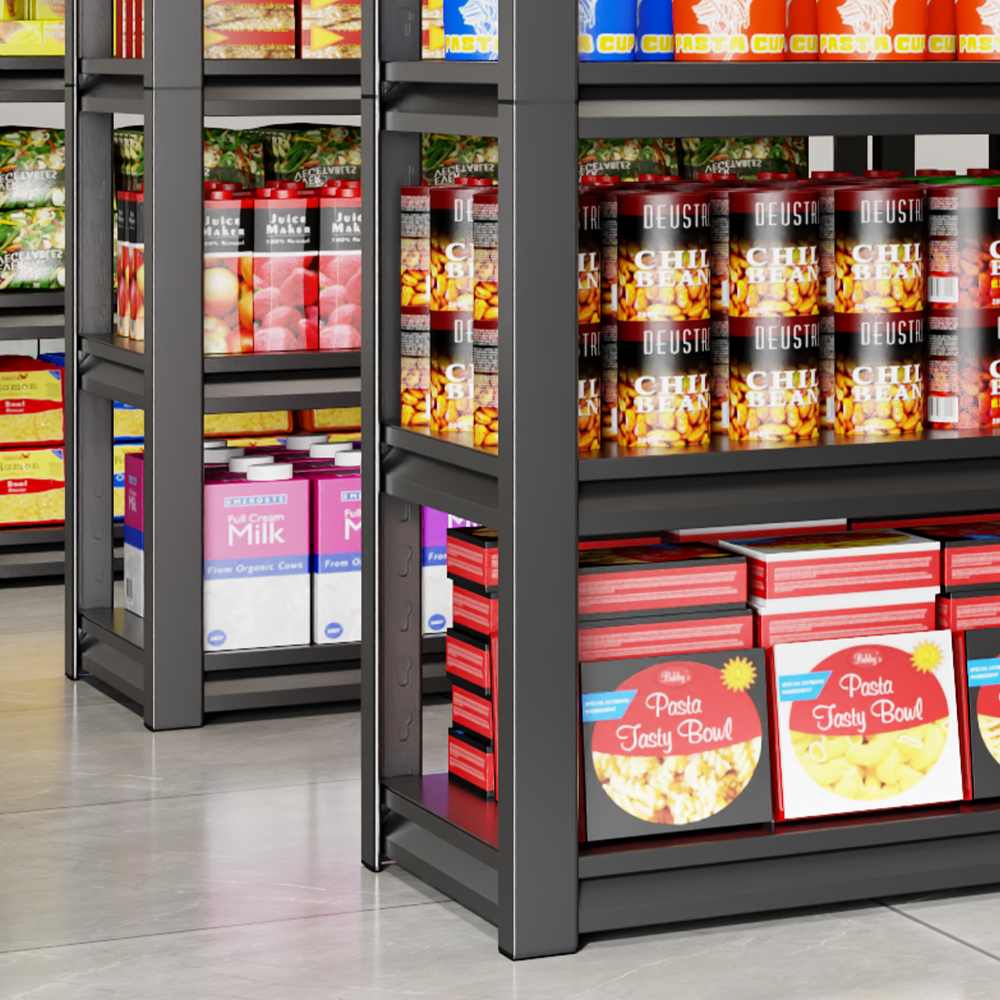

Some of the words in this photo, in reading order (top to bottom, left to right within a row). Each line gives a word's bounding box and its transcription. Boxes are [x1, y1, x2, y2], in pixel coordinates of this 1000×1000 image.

[597, 34, 635, 54] CUP
[675, 34, 750, 54] PASTA
[751, 34, 786, 54] CUP
[820, 34, 892, 54] PASTA
[270, 213, 306, 224] Juice
[643, 203, 710, 229] DEUSTR
[755, 200, 820, 226] DEUSTR
[860, 198, 924, 224] DEUSTR
[228, 514, 246, 524] Full
[249, 514, 284, 523] Cream
[228, 522, 285, 546] Milk
[208, 566, 232, 574] From
[236, 563, 274, 574] Organic
[278, 561, 303, 570] Cows
[325, 559, 349, 568] From
[839, 673, 894, 697] Pasta
[645, 692, 702, 717] Pasta
[812, 704, 866, 733] Tasty
[870, 697, 923, 723] Bowl
[616, 724, 672, 754] Tasty
[677, 717, 733, 744] Bowl
